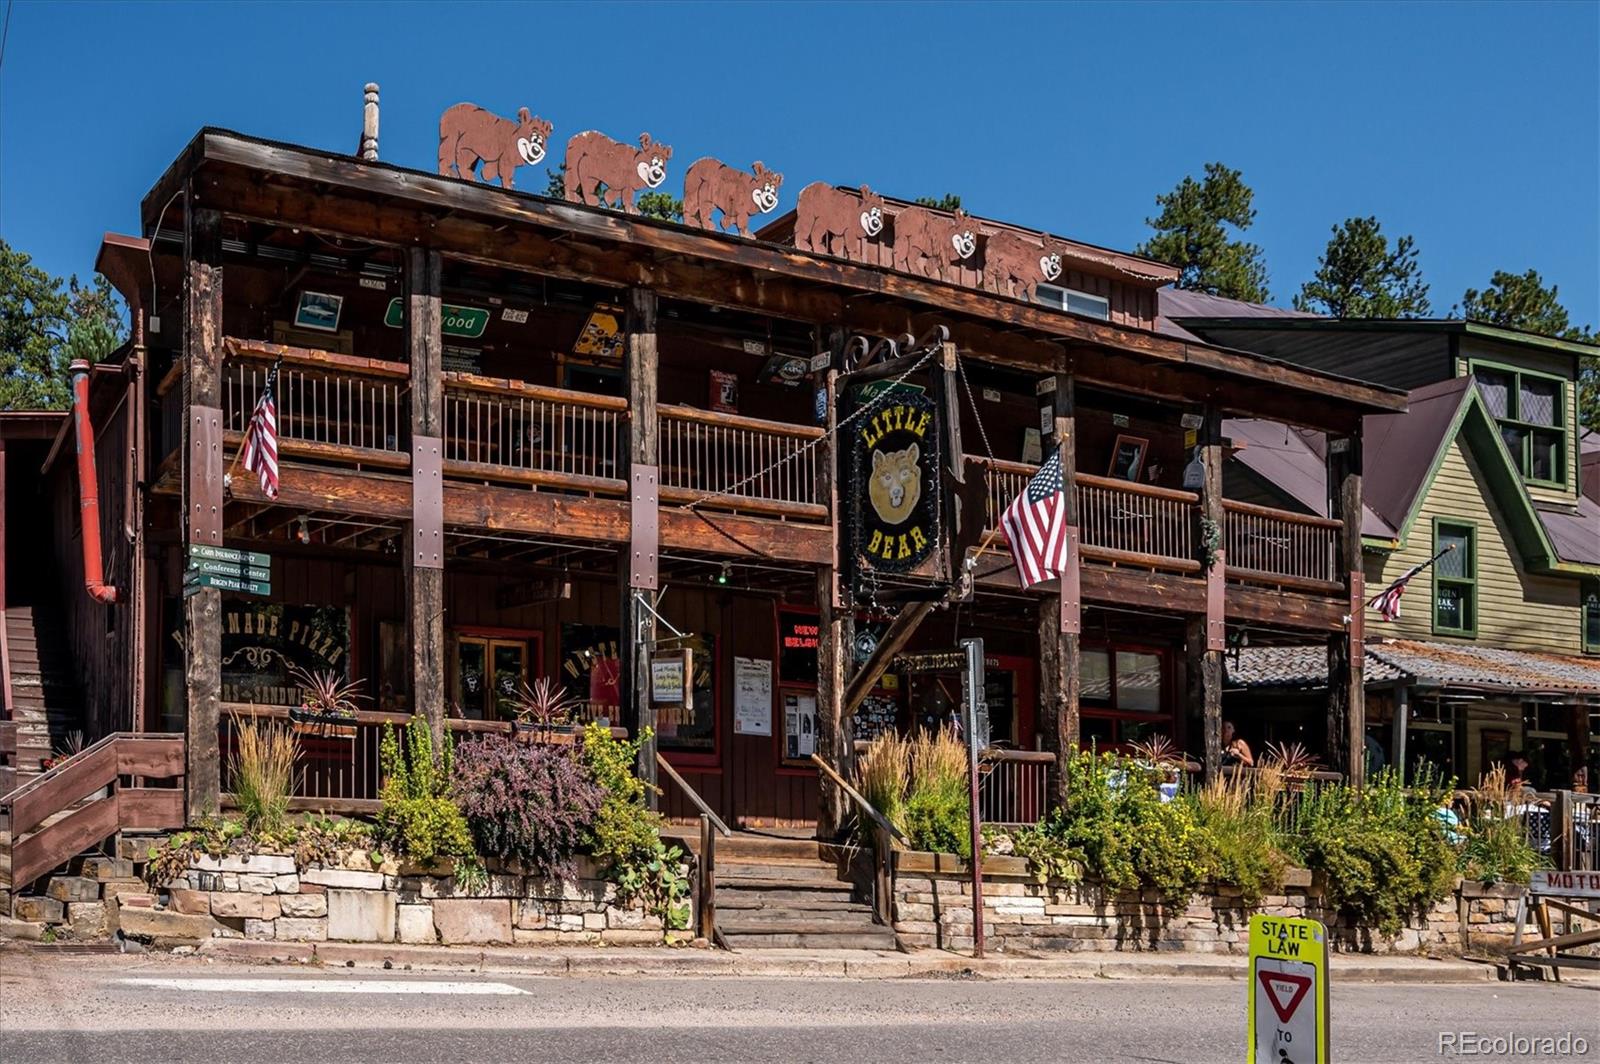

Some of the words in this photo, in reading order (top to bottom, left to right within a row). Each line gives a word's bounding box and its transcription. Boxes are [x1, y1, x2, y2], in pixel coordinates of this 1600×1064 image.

[861, 406, 932, 449] LITTLE
[867, 525, 927, 560] BEAR
[203, 562, 241, 575] Conference
[243, 567, 267, 579] Center
[794, 625, 819, 636] NEW
[288, 619, 344, 665] PIZZA
[1260, 920, 1309, 940] STATE
[1268, 938, 1300, 956] LAW
[1275, 983, 1294, 994] YIELD
[1277, 1028, 1293, 1043] TO
